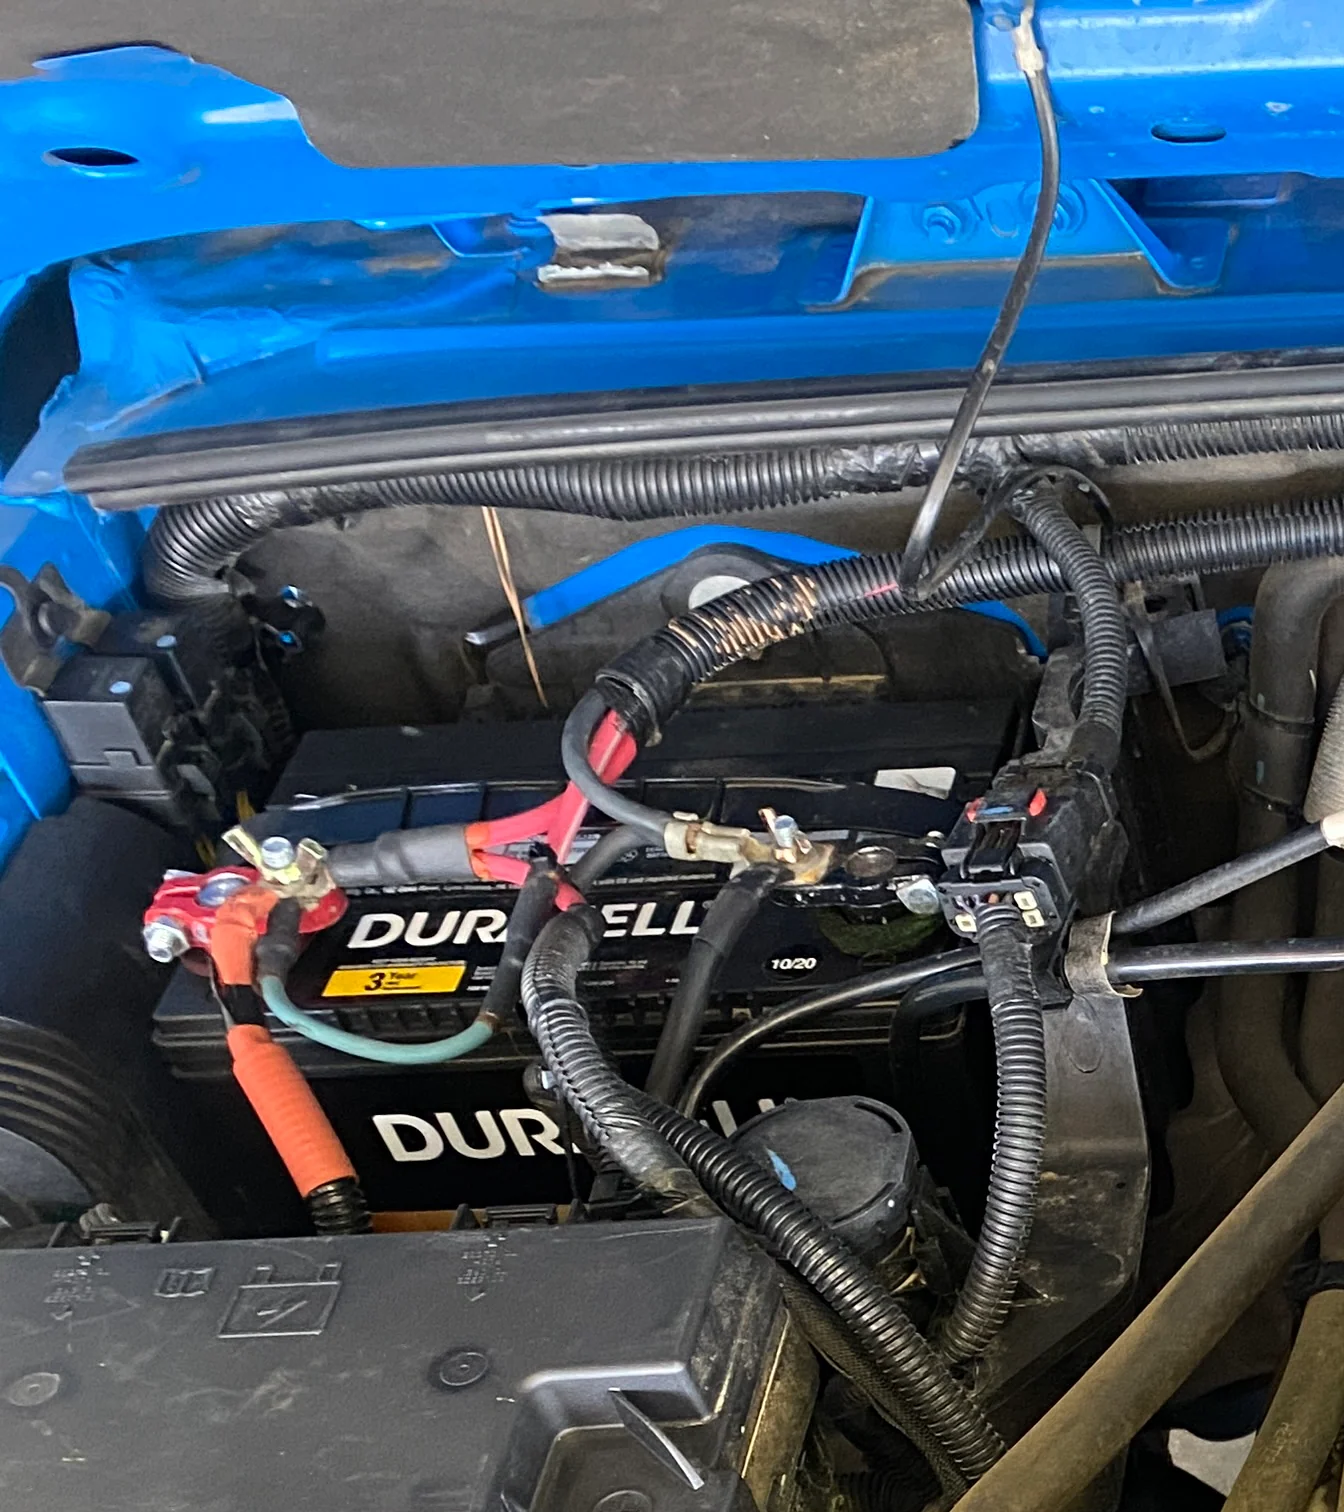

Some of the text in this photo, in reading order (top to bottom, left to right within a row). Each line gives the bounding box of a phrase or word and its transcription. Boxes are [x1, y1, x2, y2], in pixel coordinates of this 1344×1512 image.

[347, 900, 700, 948] DURELL
[771, 957, 817, 970] 10/20
[364, 972, 385, 991] 3
